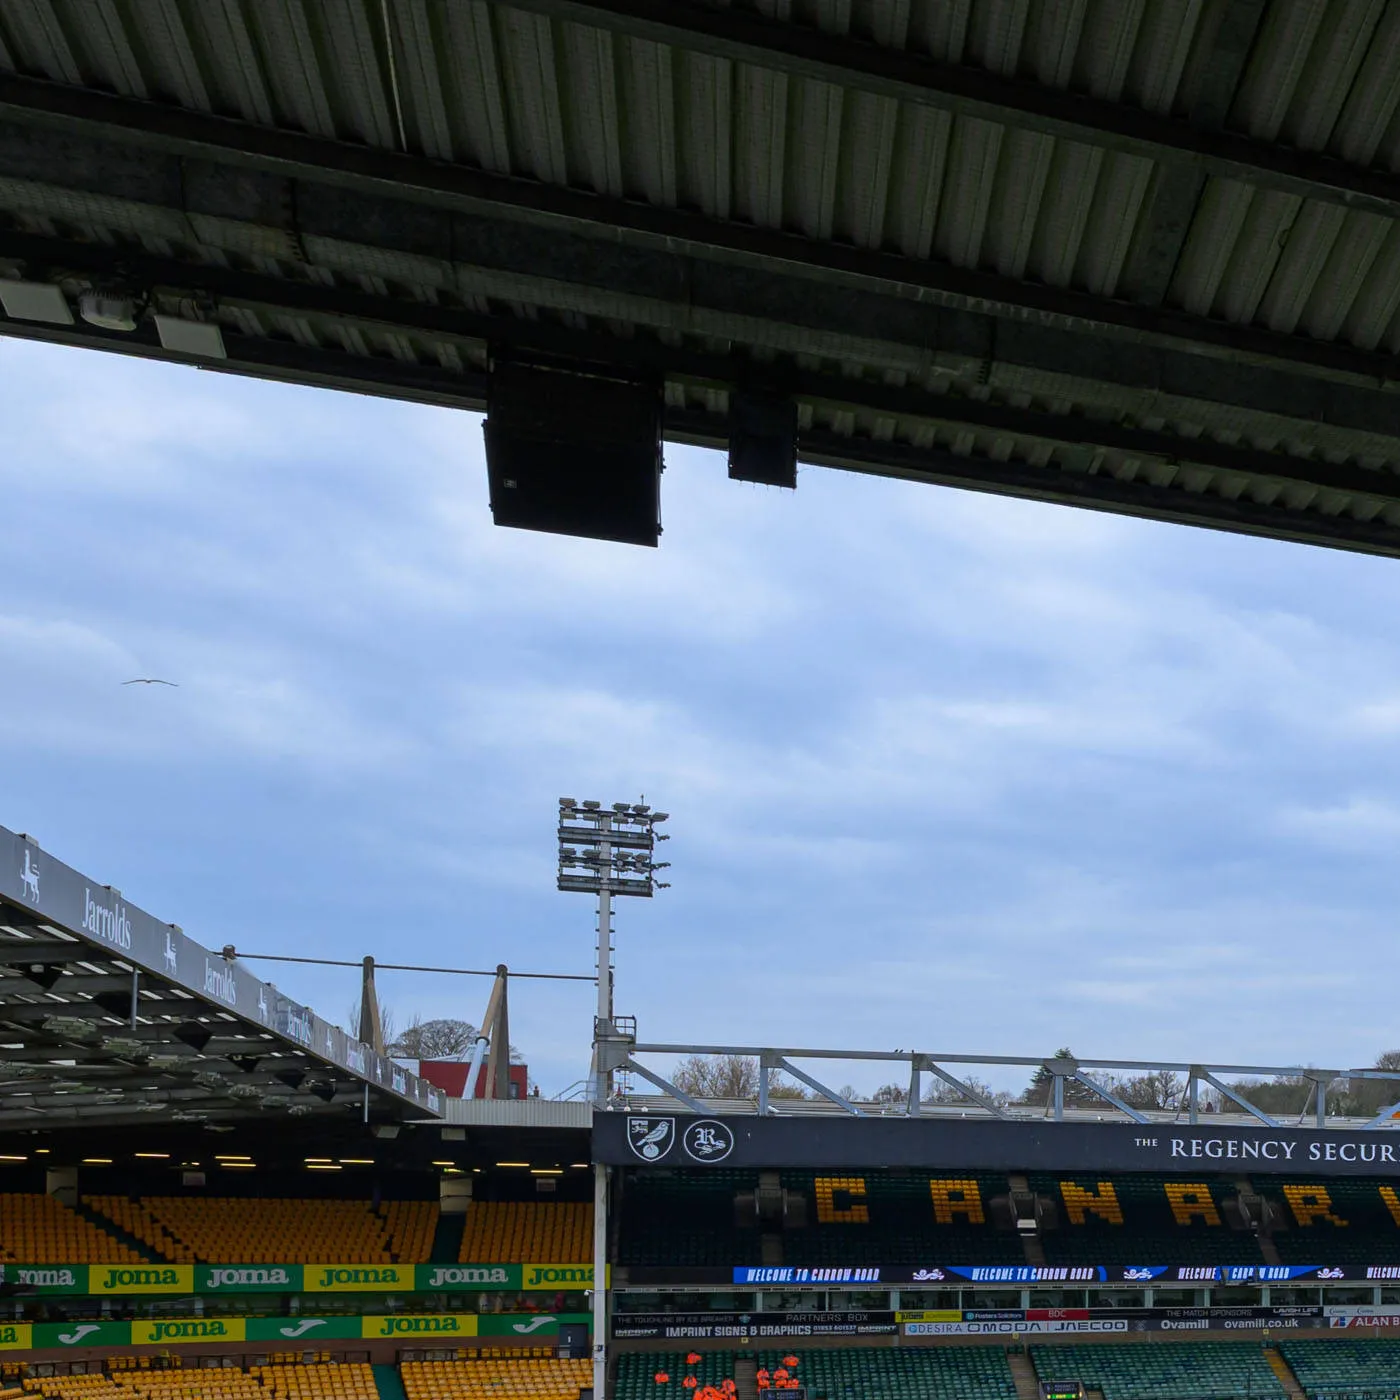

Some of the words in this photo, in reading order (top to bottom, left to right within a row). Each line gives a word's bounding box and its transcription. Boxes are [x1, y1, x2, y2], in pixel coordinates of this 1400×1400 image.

[82, 888, 132, 950] Jarrolds
[203, 957, 237, 1006] Jarrolds
[1134, 1138, 1158, 1147] THE
[1169, 1138, 1297, 1160] REGENCY
[103, 1268, 180, 1289] Joma
[207, 1267, 290, 1288] Joma
[320, 1267, 400, 1287] Joma
[429, 1267, 509, 1287] Joma
[747, 1268, 793, 1282] WELCOME
[796, 1268, 809, 1282] TO
[811, 1268, 853, 1282] CARROW
[854, 1268, 880, 1282] ROAD
[971, 1267, 1015, 1281] WELCOME
[1016, 1267, 1029, 1281] TO
[1030, 1267, 1068, 1281] CARROW
[1069, 1267, 1094, 1281] ROAD
[1178, 1267, 1217, 1280] WELCOME
[1267, 1267, 1290, 1280] ROAD
[847, 1313, 869, 1322] BOX
[1167, 1309, 1182, 1317] THE
[1183, 1309, 1209, 1317] MATCH
[380, 1315, 460, 1336] Joma
[918, 1324, 962, 1333] DESIRA
[967, 1322, 1041, 1332] OMODA
[1055, 1321, 1126, 1331] JAECOO
[1161, 1319, 1209, 1329] Ovamill
[1224, 1318, 1299, 1328] ovamill.co.uk
[1356, 1317, 1389, 1326] ALAN
[148, 1320, 228, 1341] Joma
[666, 1326, 713, 1337] IMPRINT
[714, 1326, 747, 1336] SIGNS
[750, 1326, 758, 1336] &
[760, 1325, 812, 1336] GRAPHICS
